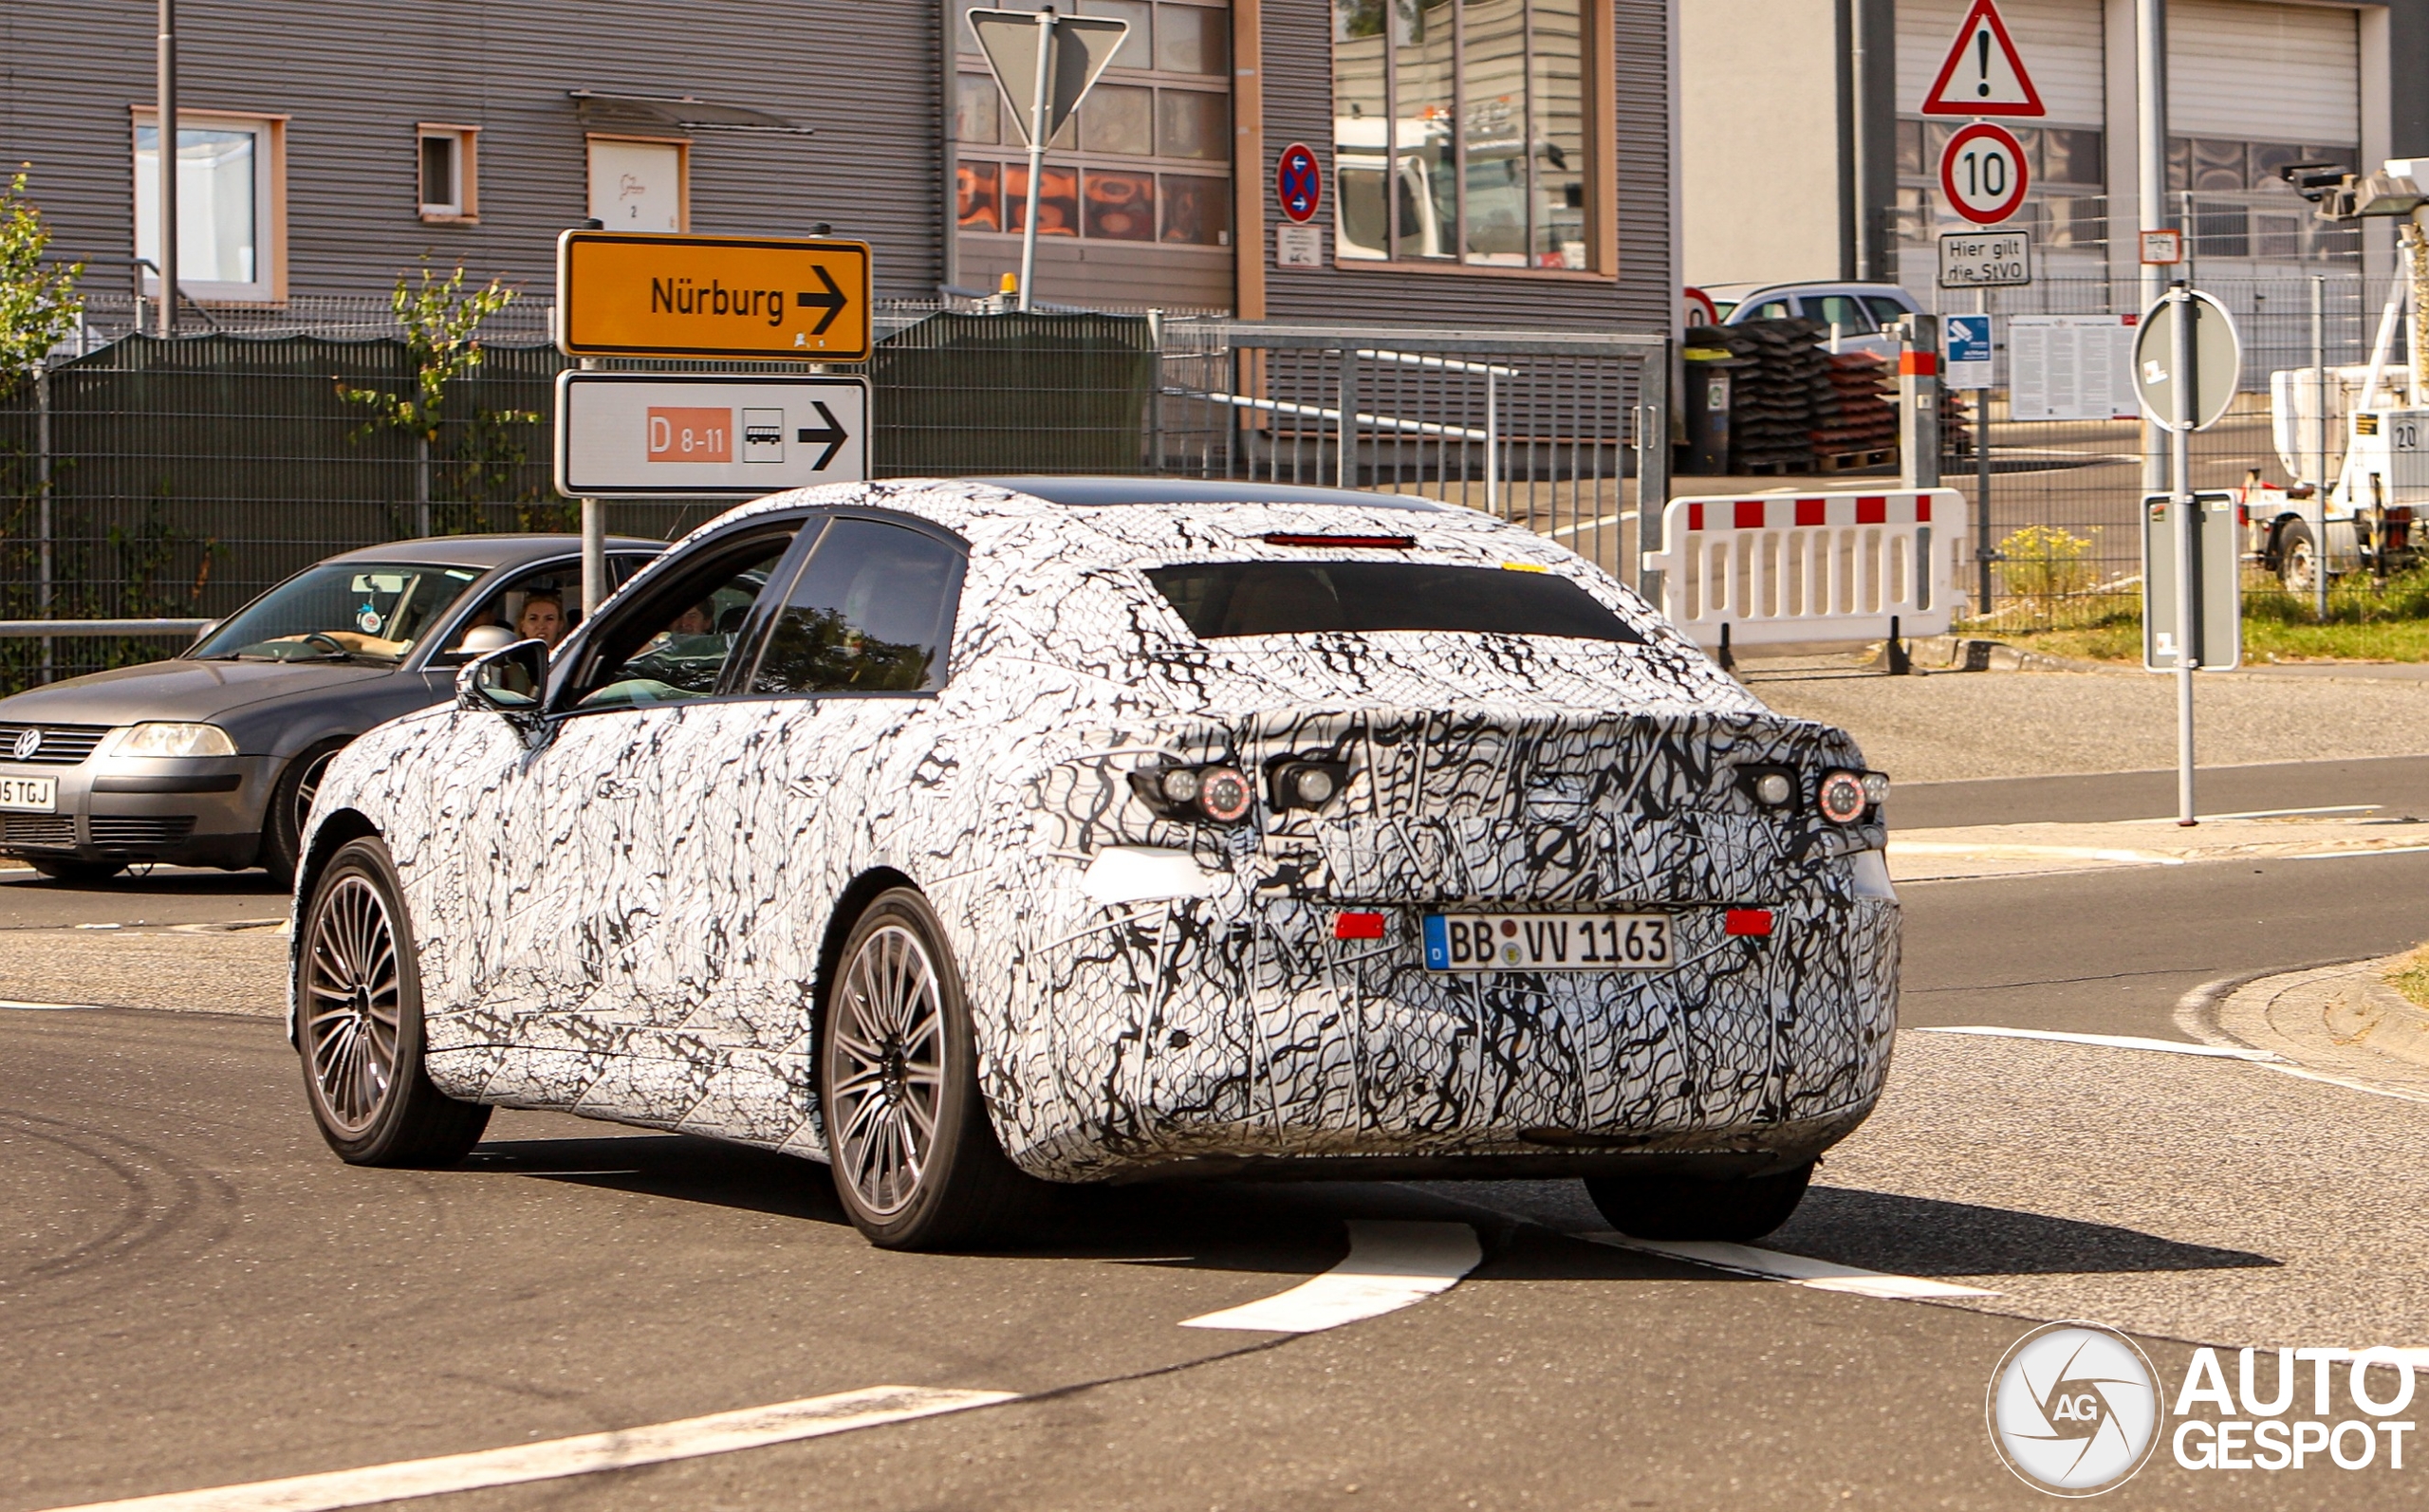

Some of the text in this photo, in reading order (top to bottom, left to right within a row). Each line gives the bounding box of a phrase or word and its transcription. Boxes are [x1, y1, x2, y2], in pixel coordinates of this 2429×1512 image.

[1963, 152, 2005, 196] 10
[631, 205, 637, 218] 2
[1950, 239, 2020, 260] Hier gilt
[1948, 262, 2022, 280] die StVO
[652, 277, 784, 326] Nürburg
[650, 416, 723, 452] D 8-11
[2396, 426, 2417, 448] 20
[17, 782, 47, 803] TGJ
[1432, 920, 1667, 963] D BB VV 1163
